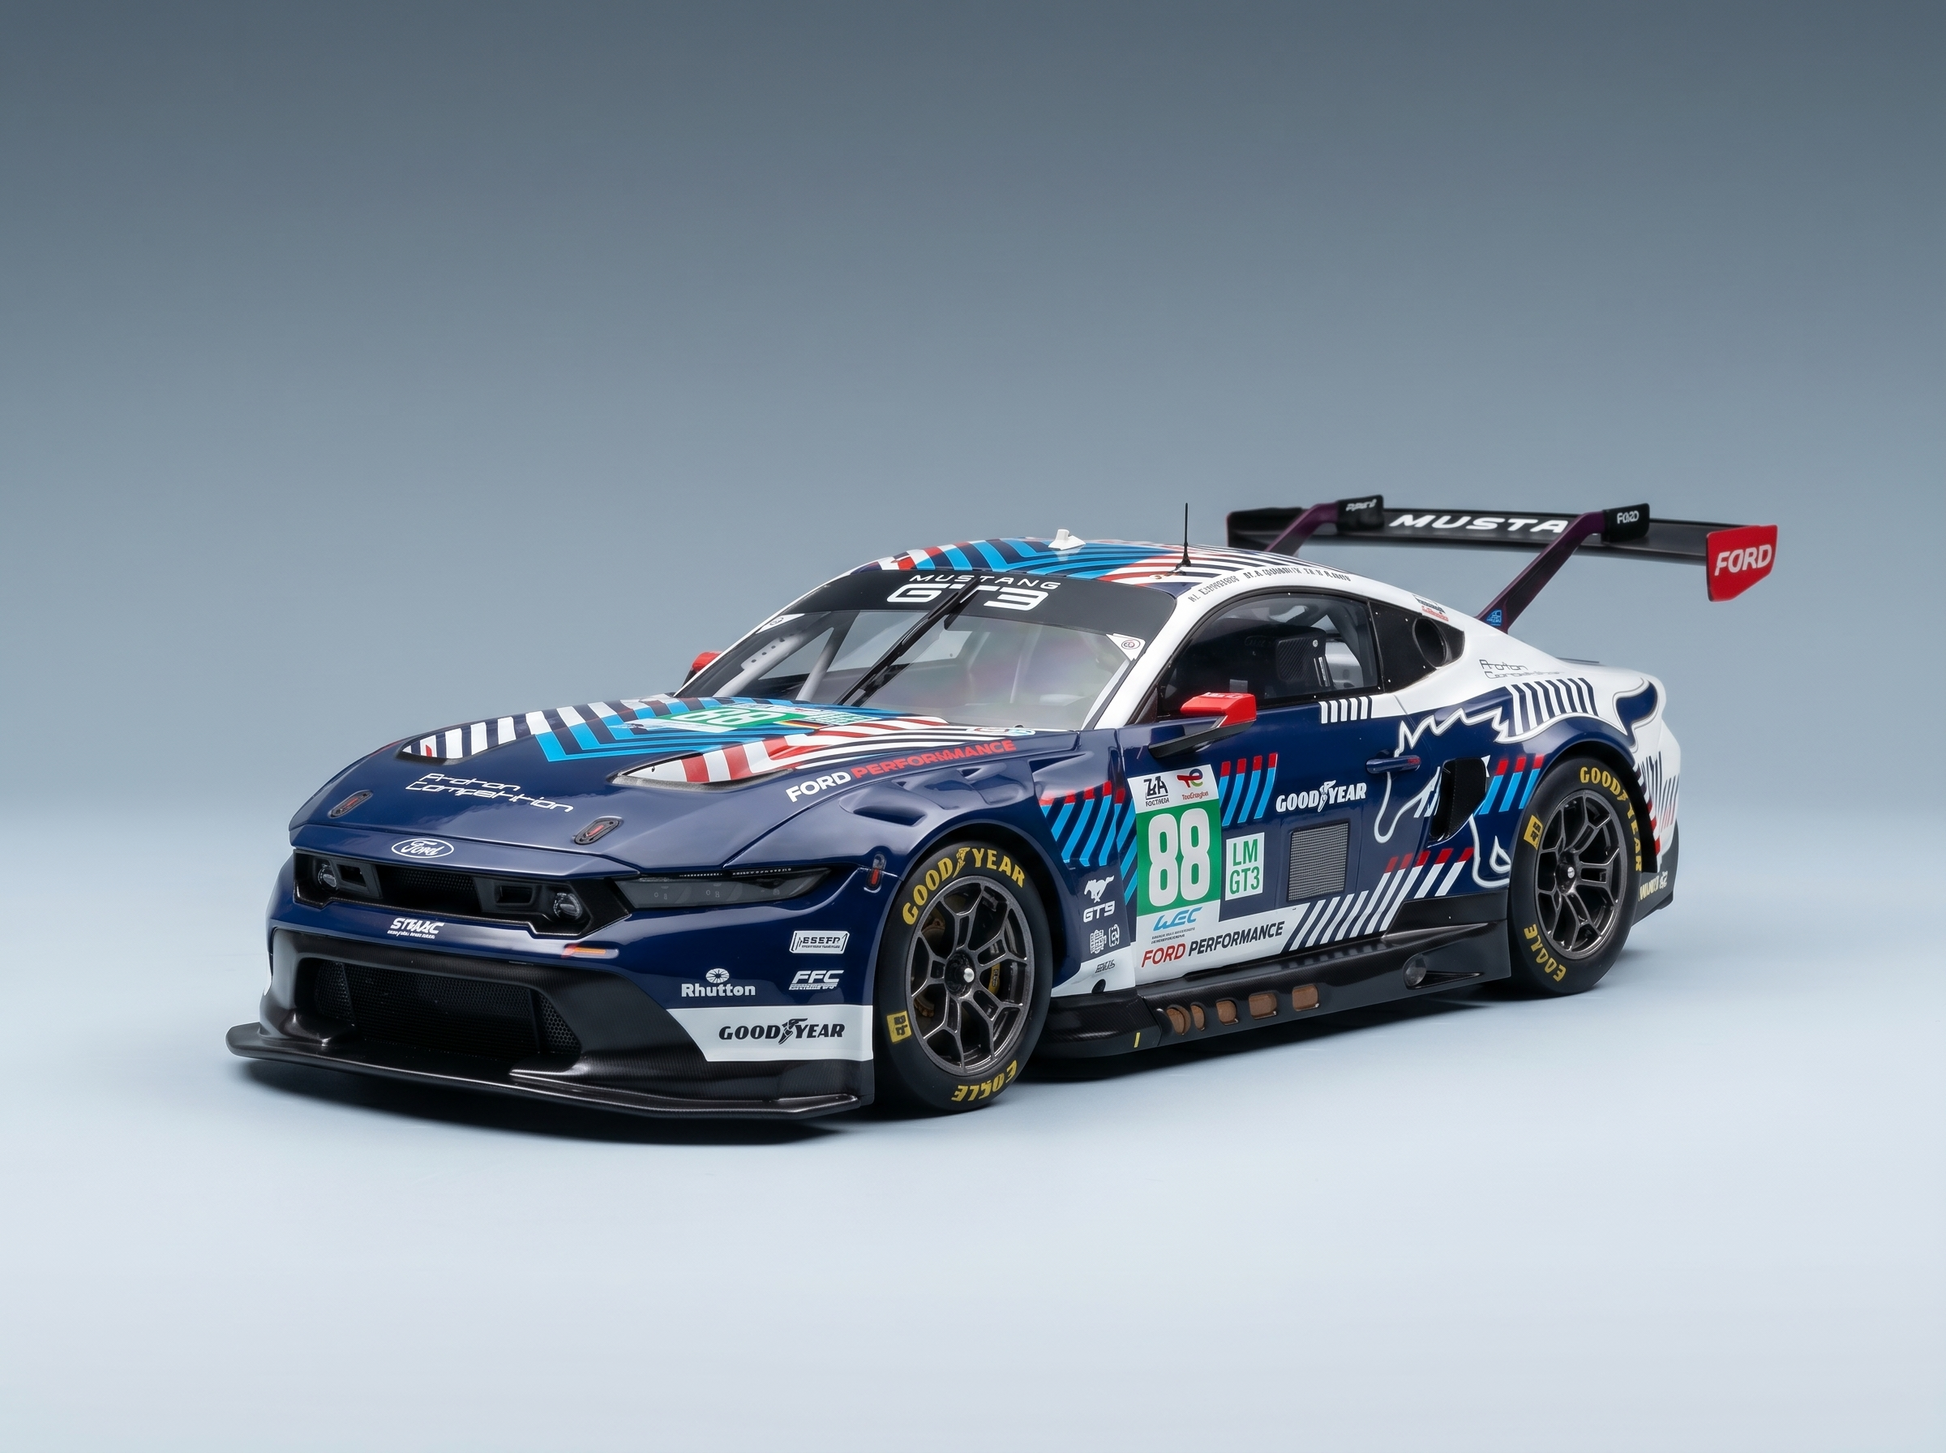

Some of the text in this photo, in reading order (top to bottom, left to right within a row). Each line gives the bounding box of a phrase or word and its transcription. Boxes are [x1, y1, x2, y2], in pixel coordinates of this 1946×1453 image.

[1714, 544, 1773, 576] FORD
[908, 574, 1062, 590] MUSTANG
[418, 773, 521, 792] Proton
[786, 771, 851, 803] FORD
[400, 839, 445, 857] Ford
[1148, 808, 1210, 907] 88
[1233, 838, 1259, 867] LM
[1229, 866, 1260, 895] GT3
[1152, 906, 1203, 932] WEC
[1141, 942, 1186, 968] FORD
[1188, 920, 1285, 957] PERFORMANCE
[790, 969, 845, 984] FFC
[681, 983, 756, 998] Rhutton
